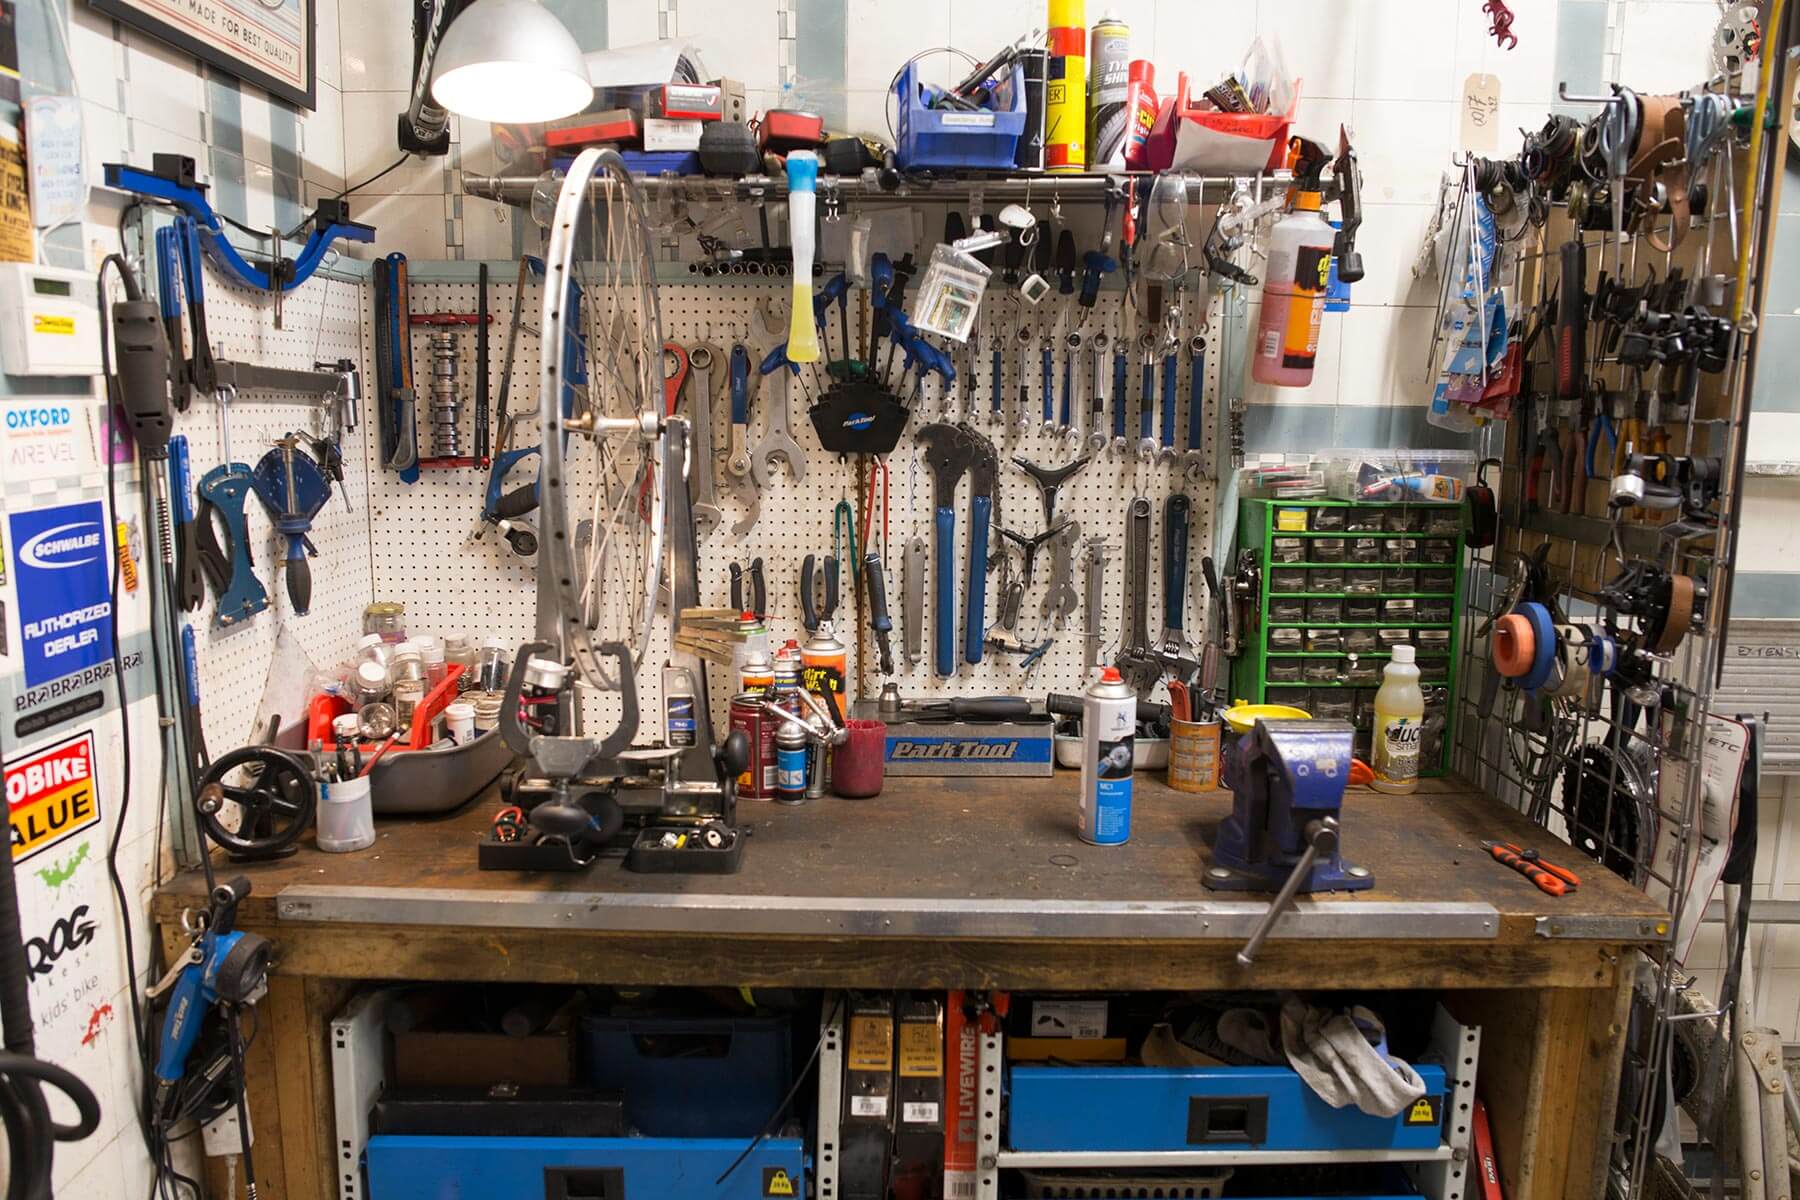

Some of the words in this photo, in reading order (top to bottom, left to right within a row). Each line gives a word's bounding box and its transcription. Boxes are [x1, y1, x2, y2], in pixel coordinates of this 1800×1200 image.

[222, 17, 240, 36] FOR
[243, 28, 261, 48] BEST
[264, 40, 293, 64] QUALITY
[6, 407, 71, 429] OXFORD
[34, 532, 101, 558] SCHWALBE
[24, 601, 112, 641] AUTHORIZED
[43, 627, 98, 659] DEALER
[73, 975, 99, 1001] bike
[960, 1025, 976, 1118] LIVEWIRE
